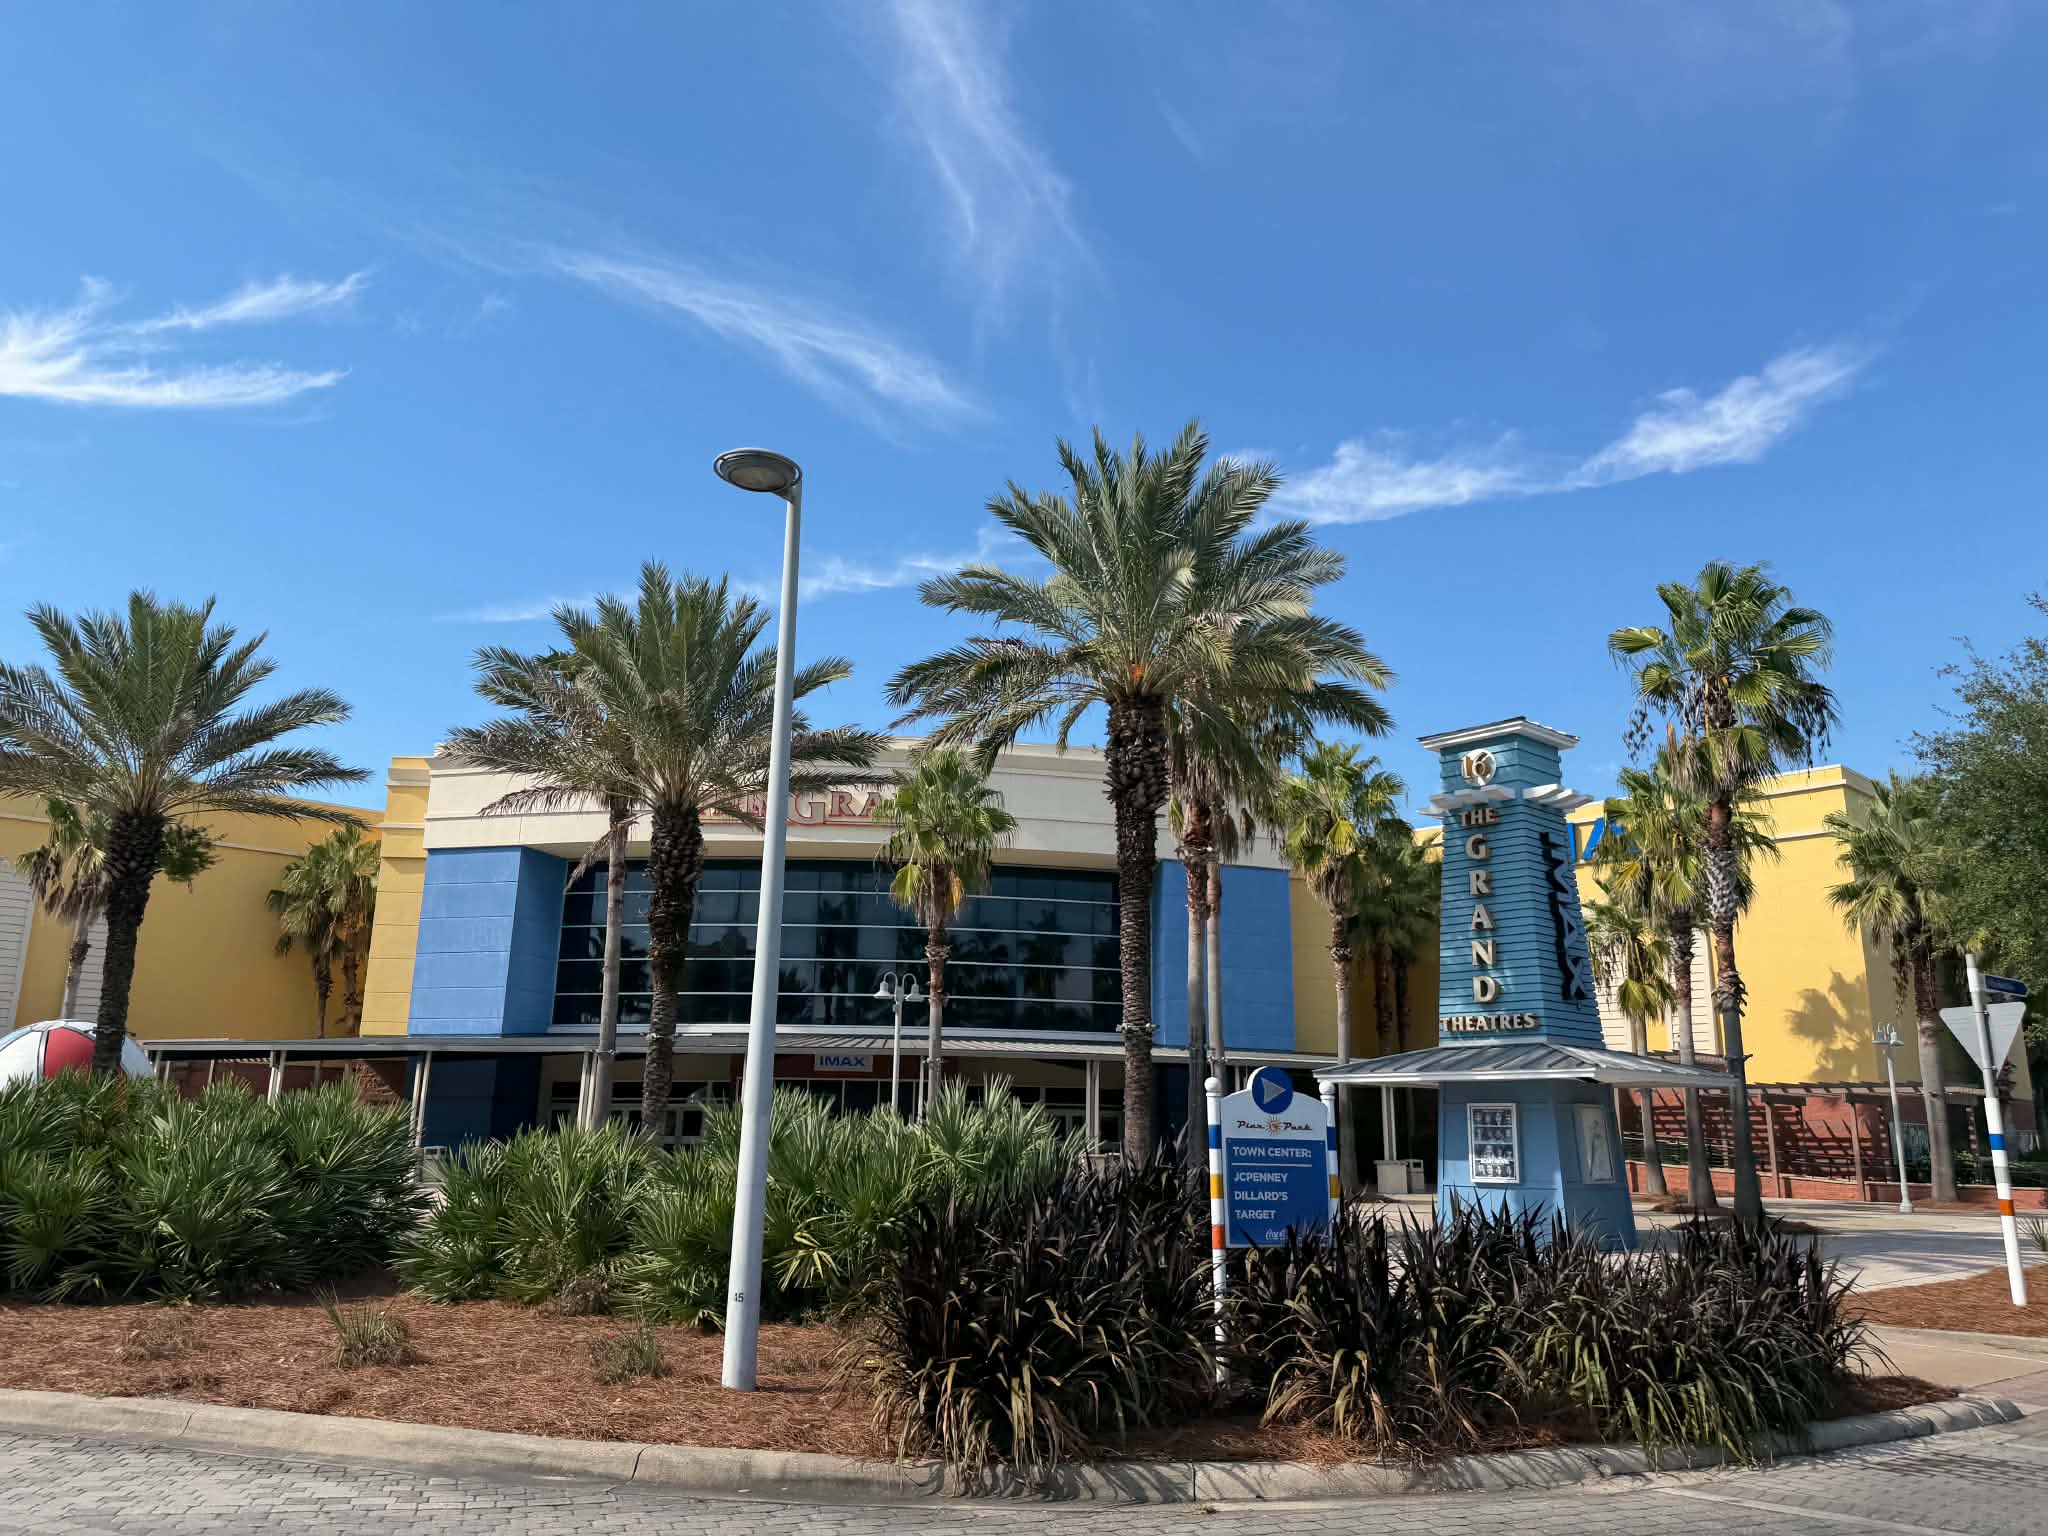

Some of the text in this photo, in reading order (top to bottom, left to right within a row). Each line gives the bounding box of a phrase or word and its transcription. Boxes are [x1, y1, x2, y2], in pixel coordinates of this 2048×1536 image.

[1463, 751, 1488, 779] 16
[1458, 807, 1498, 828] THE
[1465, 833, 1499, 1004] GRAND
[1441, 1014, 1537, 1033] THEATRES
[819, 1055, 865, 1067] IMAX
[1236, 1120, 1265, 1129] Pier
[1232, 1146, 1266, 1157] TOWN
[1234, 1172, 1288, 1183] JCPENNEY
[1234, 1191, 1289, 1201] DILLARD'S
[1235, 1210, 1276, 1220] TARGET
[734, 1292, 745, 1303] 15
